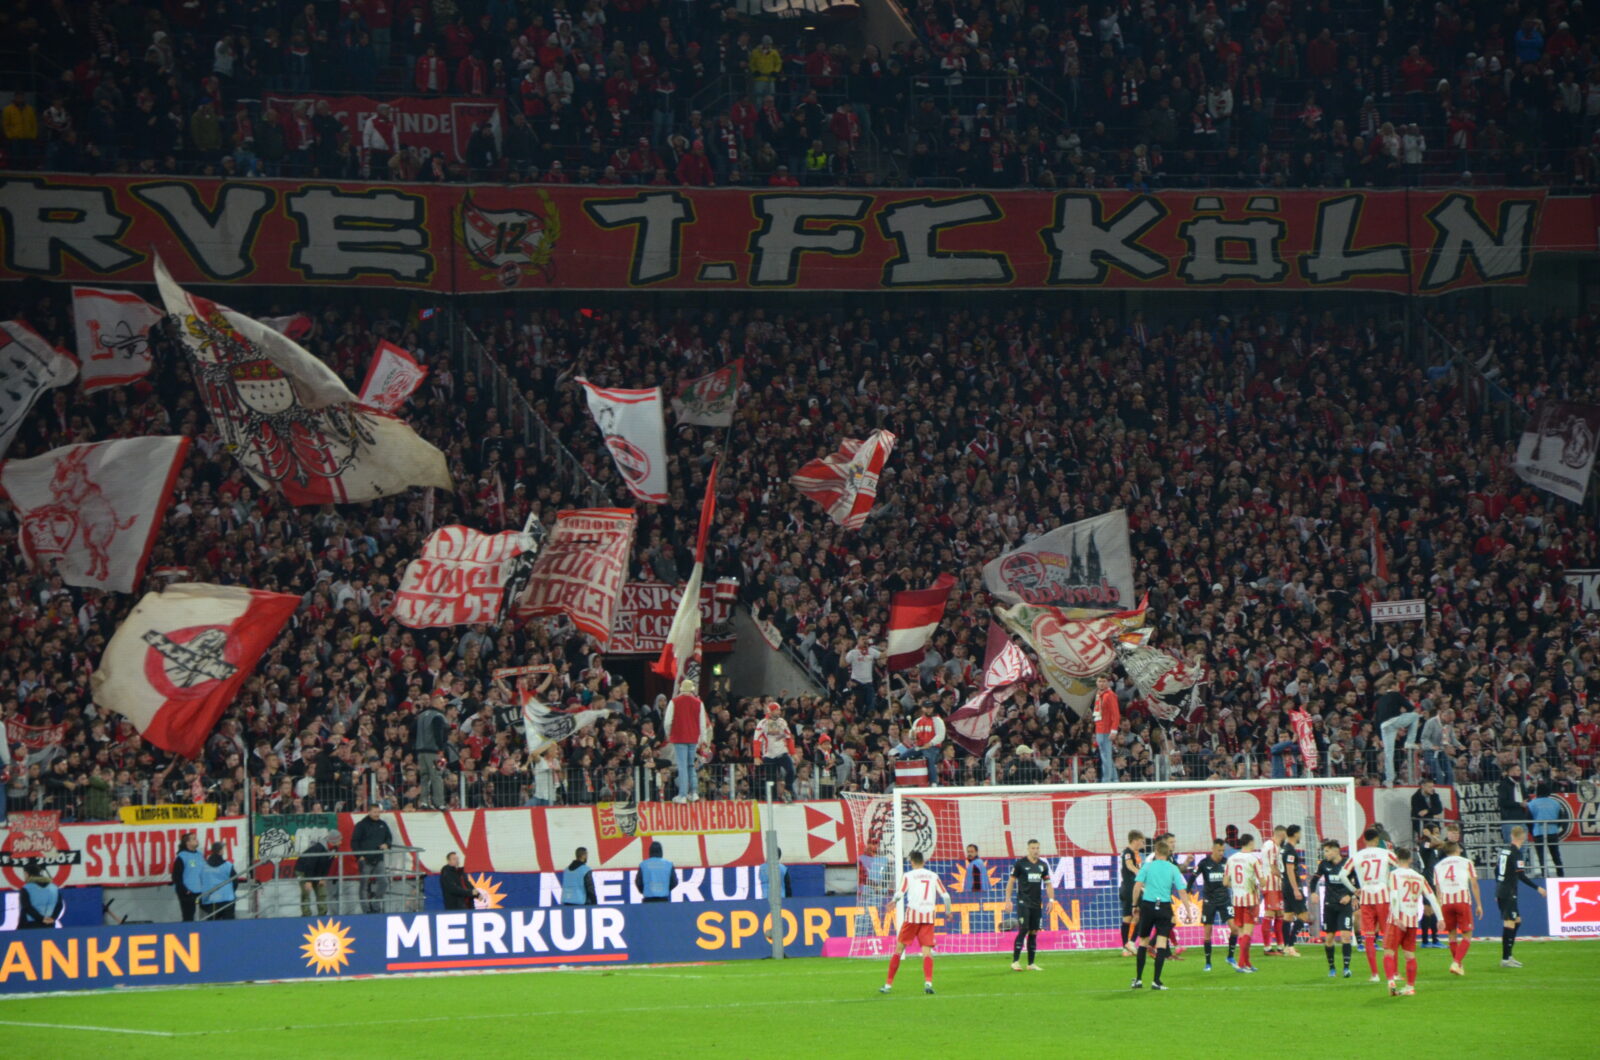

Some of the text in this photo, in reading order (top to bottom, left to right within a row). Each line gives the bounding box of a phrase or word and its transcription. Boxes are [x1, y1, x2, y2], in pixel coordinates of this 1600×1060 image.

[357, 103, 452, 130] FÜNDE
[1041, 192, 1537, 291] KÖLN
[637, 800, 754, 833] STADIONVERBOT
[85, 827, 238, 878] SYNDIAT
[1234, 863, 1245, 885] 6
[1361, 859, 1382, 881] 27
[1444, 864, 1457, 882] 4
[919, 879, 930, 901] 7
[1402, 879, 1421, 903] 29
[386, 907, 628, 959] MERKUR
[695, 898, 1082, 951] SPORTWETTN
